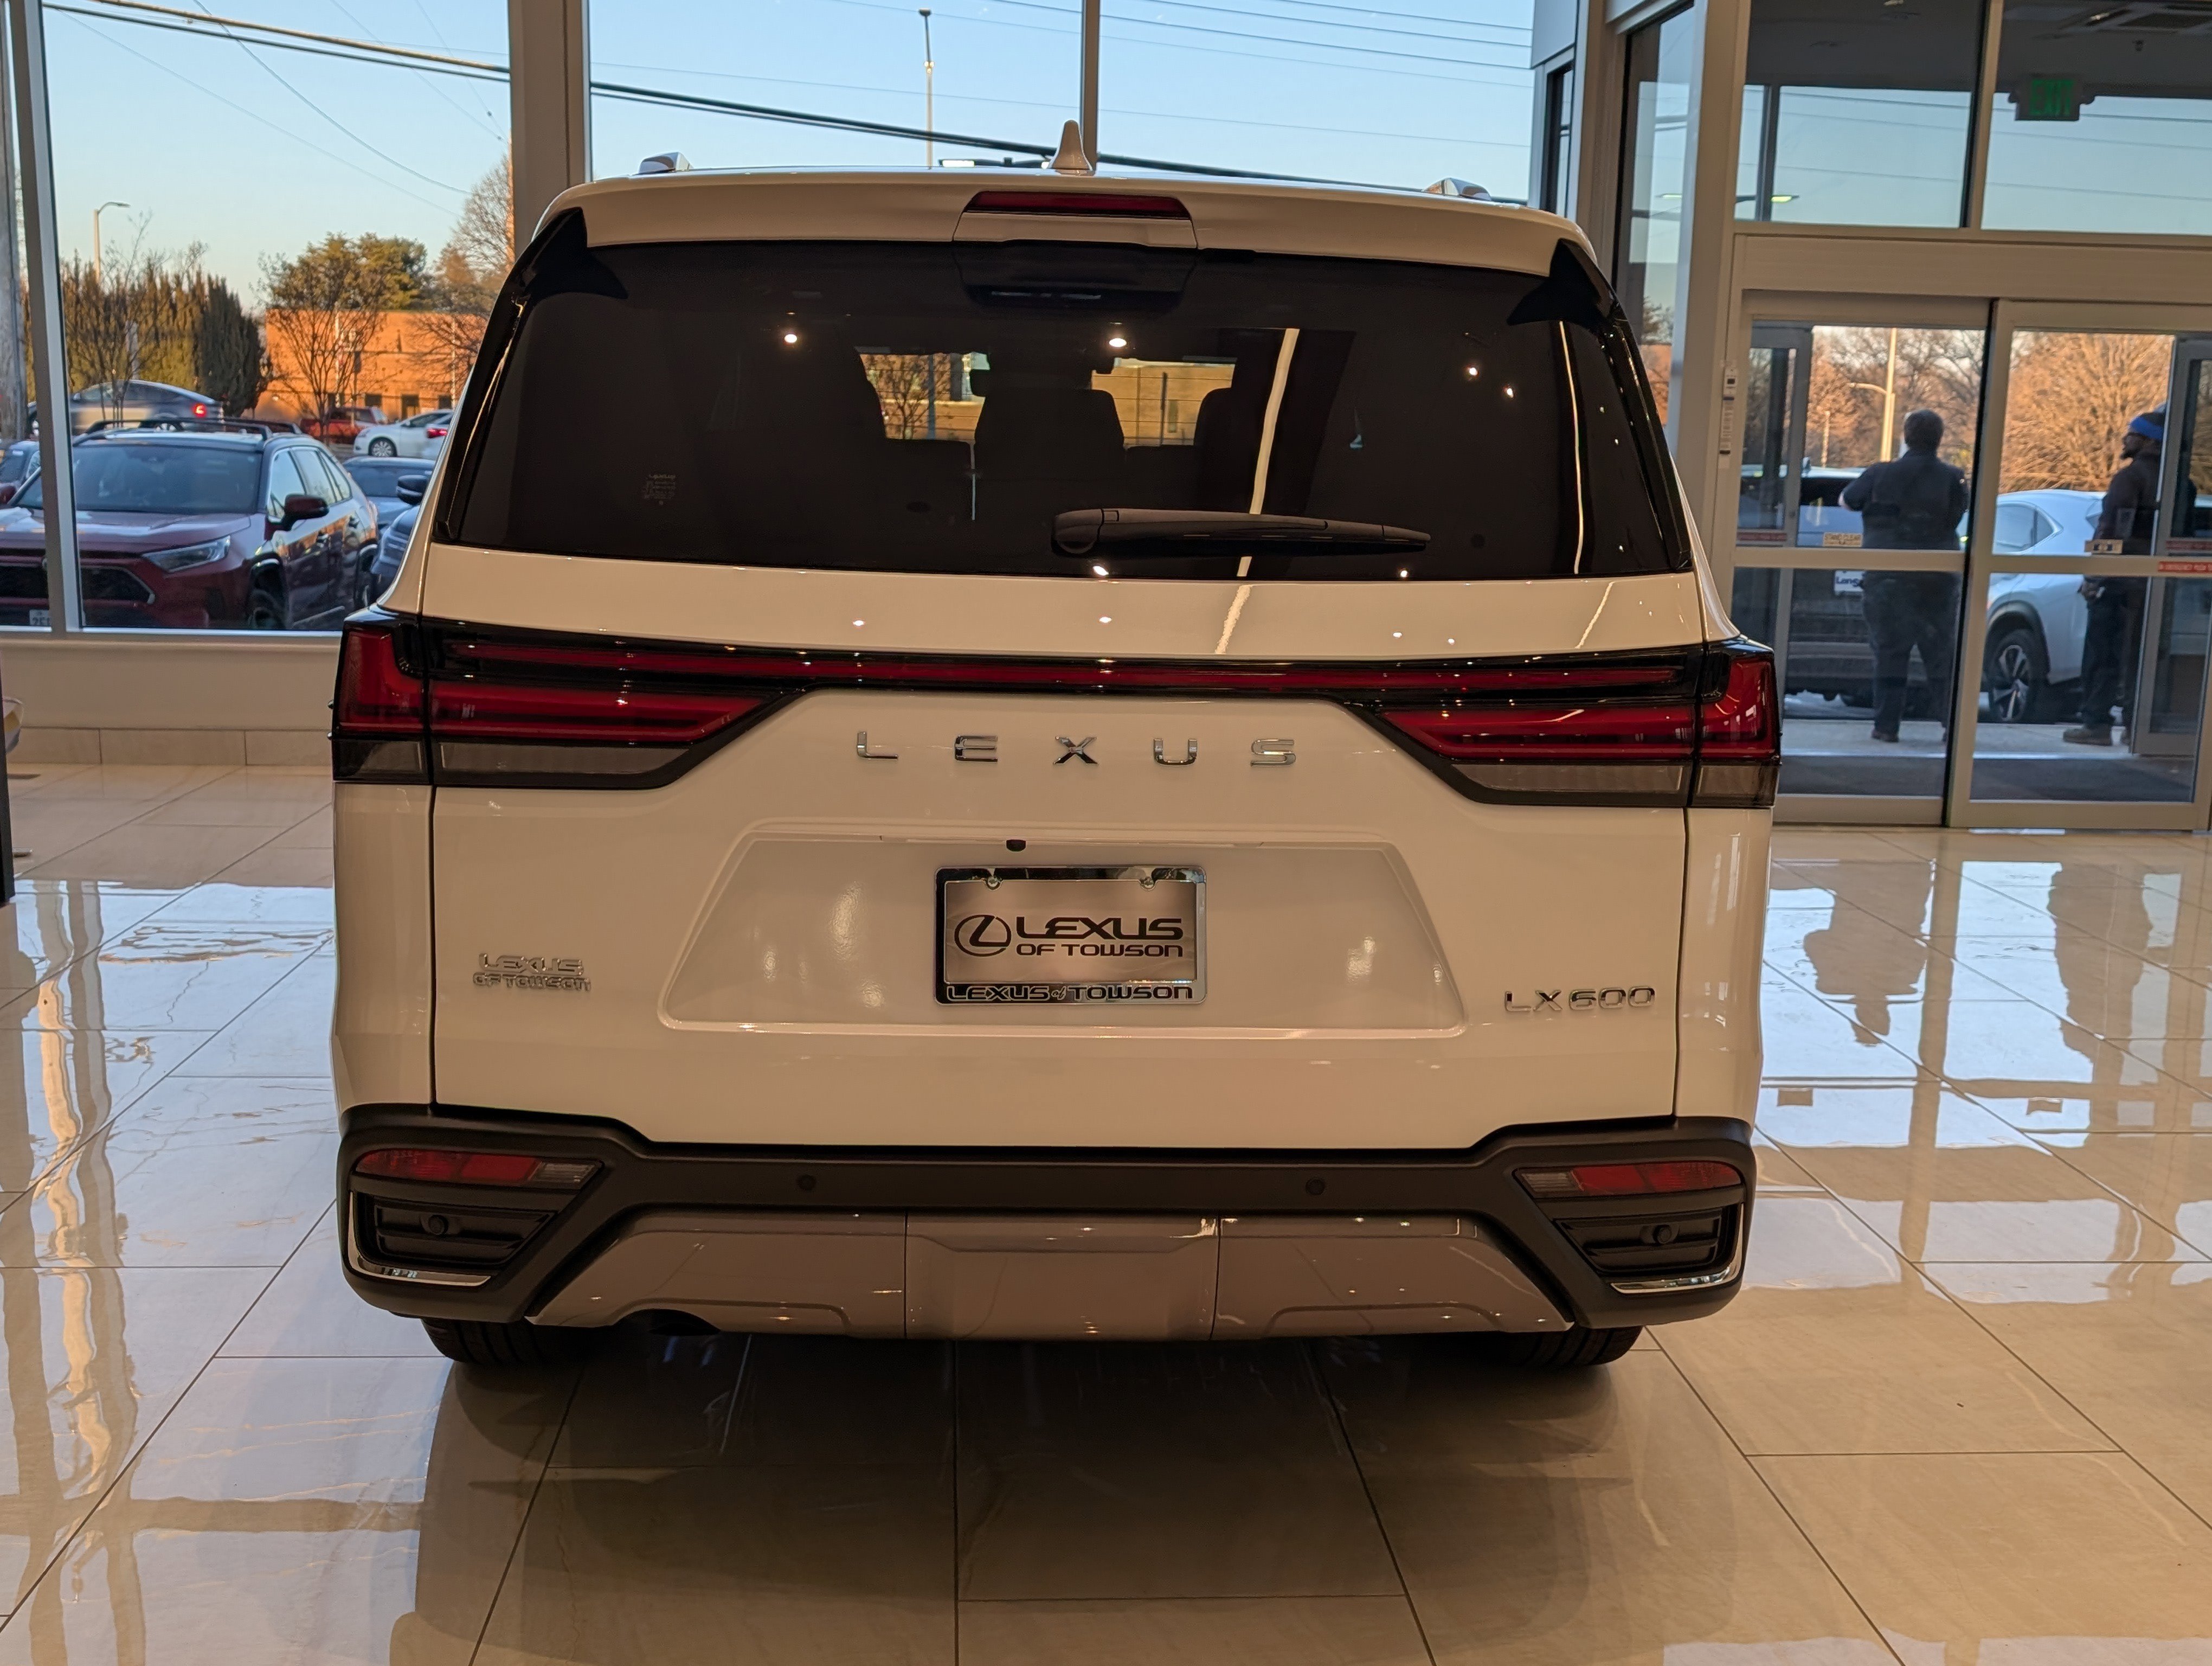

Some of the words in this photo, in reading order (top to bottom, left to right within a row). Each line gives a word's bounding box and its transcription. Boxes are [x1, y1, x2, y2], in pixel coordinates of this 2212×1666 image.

[2030, 79, 2075, 116] EXIT
[857, 731, 1297, 766] LEXUS
[1016, 916, 1184, 940] LEXUS
[1016, 943, 1056, 956] OF
[1061, 944, 1183, 957] TOWSON
[478, 952, 584, 977] LEXUS
[472, 972, 501, 988] OF
[502, 973, 591, 992] TOWSON
[947, 985, 1049, 1001] LEXUS
[1067, 985, 1193, 1001] TOWSON
